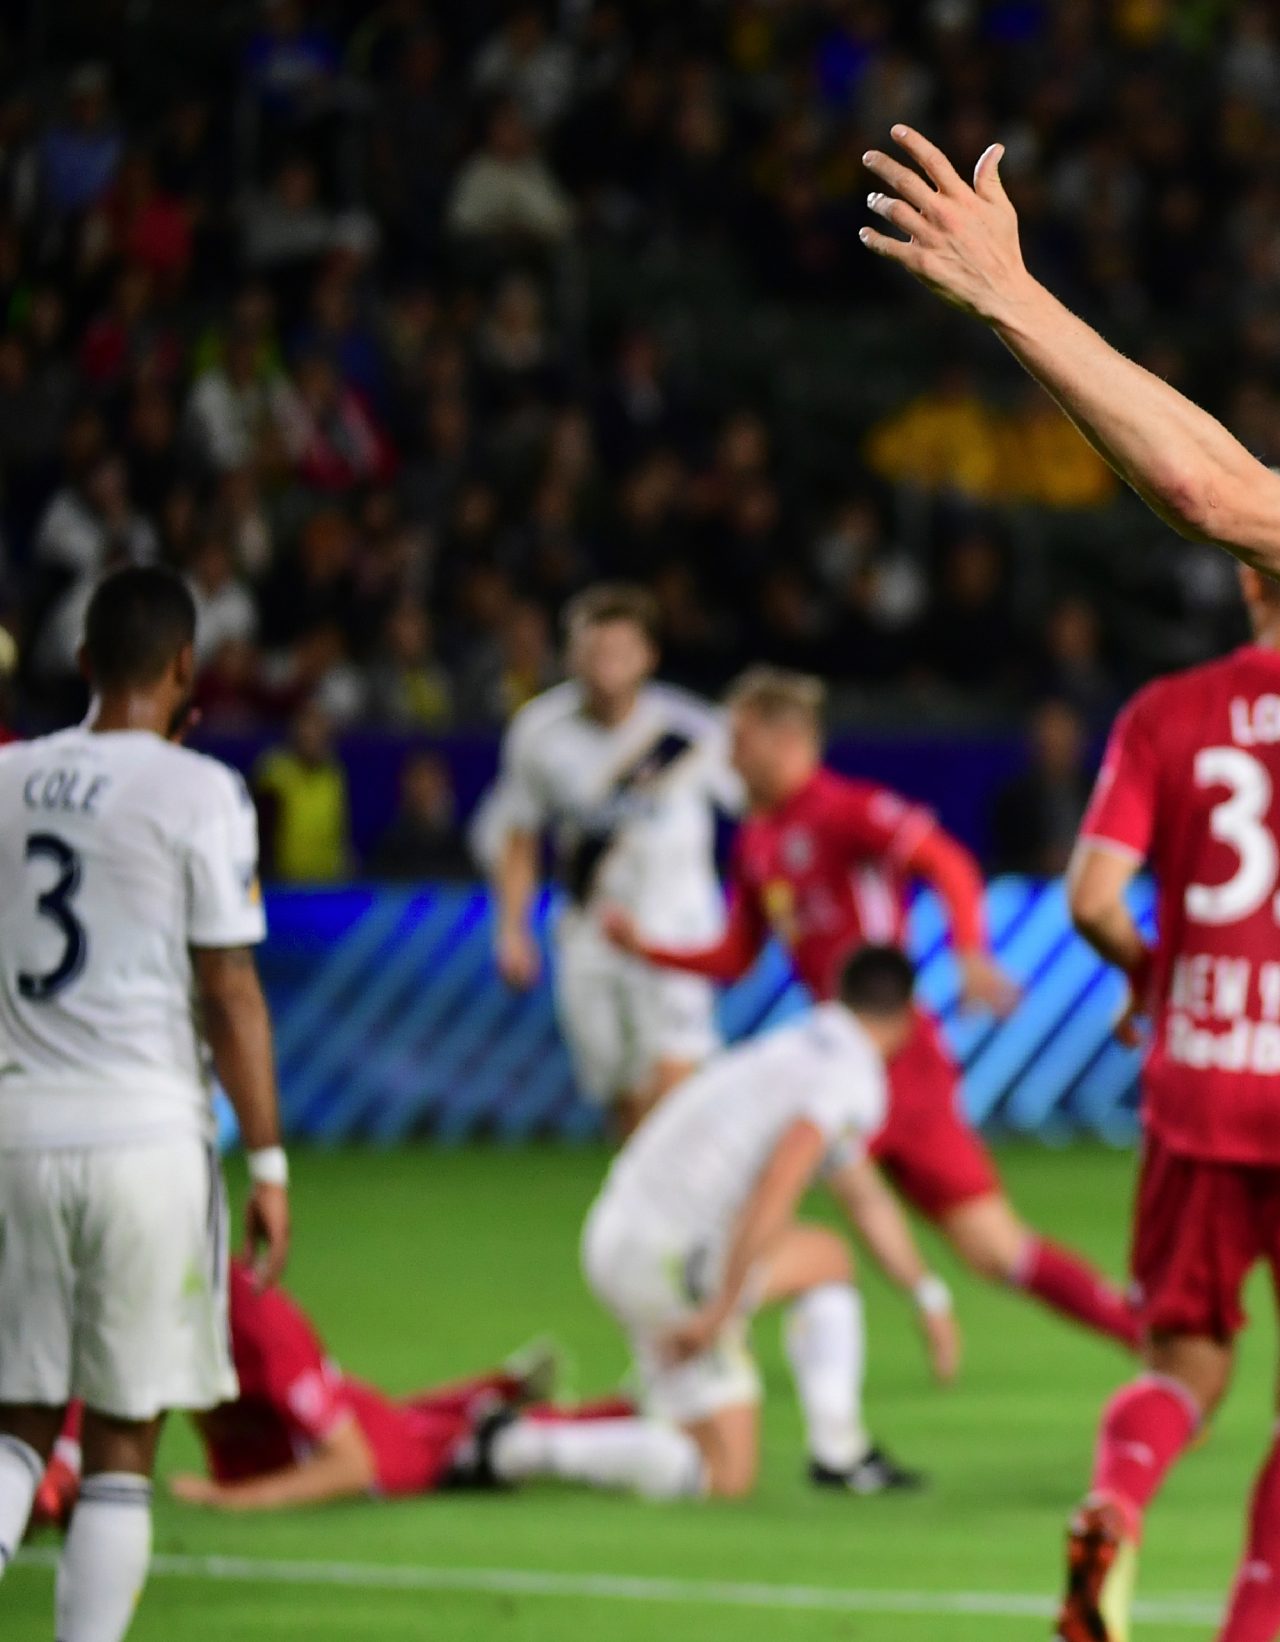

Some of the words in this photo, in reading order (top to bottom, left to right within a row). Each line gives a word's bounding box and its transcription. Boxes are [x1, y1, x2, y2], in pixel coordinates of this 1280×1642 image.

[23, 767, 112, 813] COLE
[17, 832, 89, 1003] 3
[1169, 952, 1252, 1021] NEW
